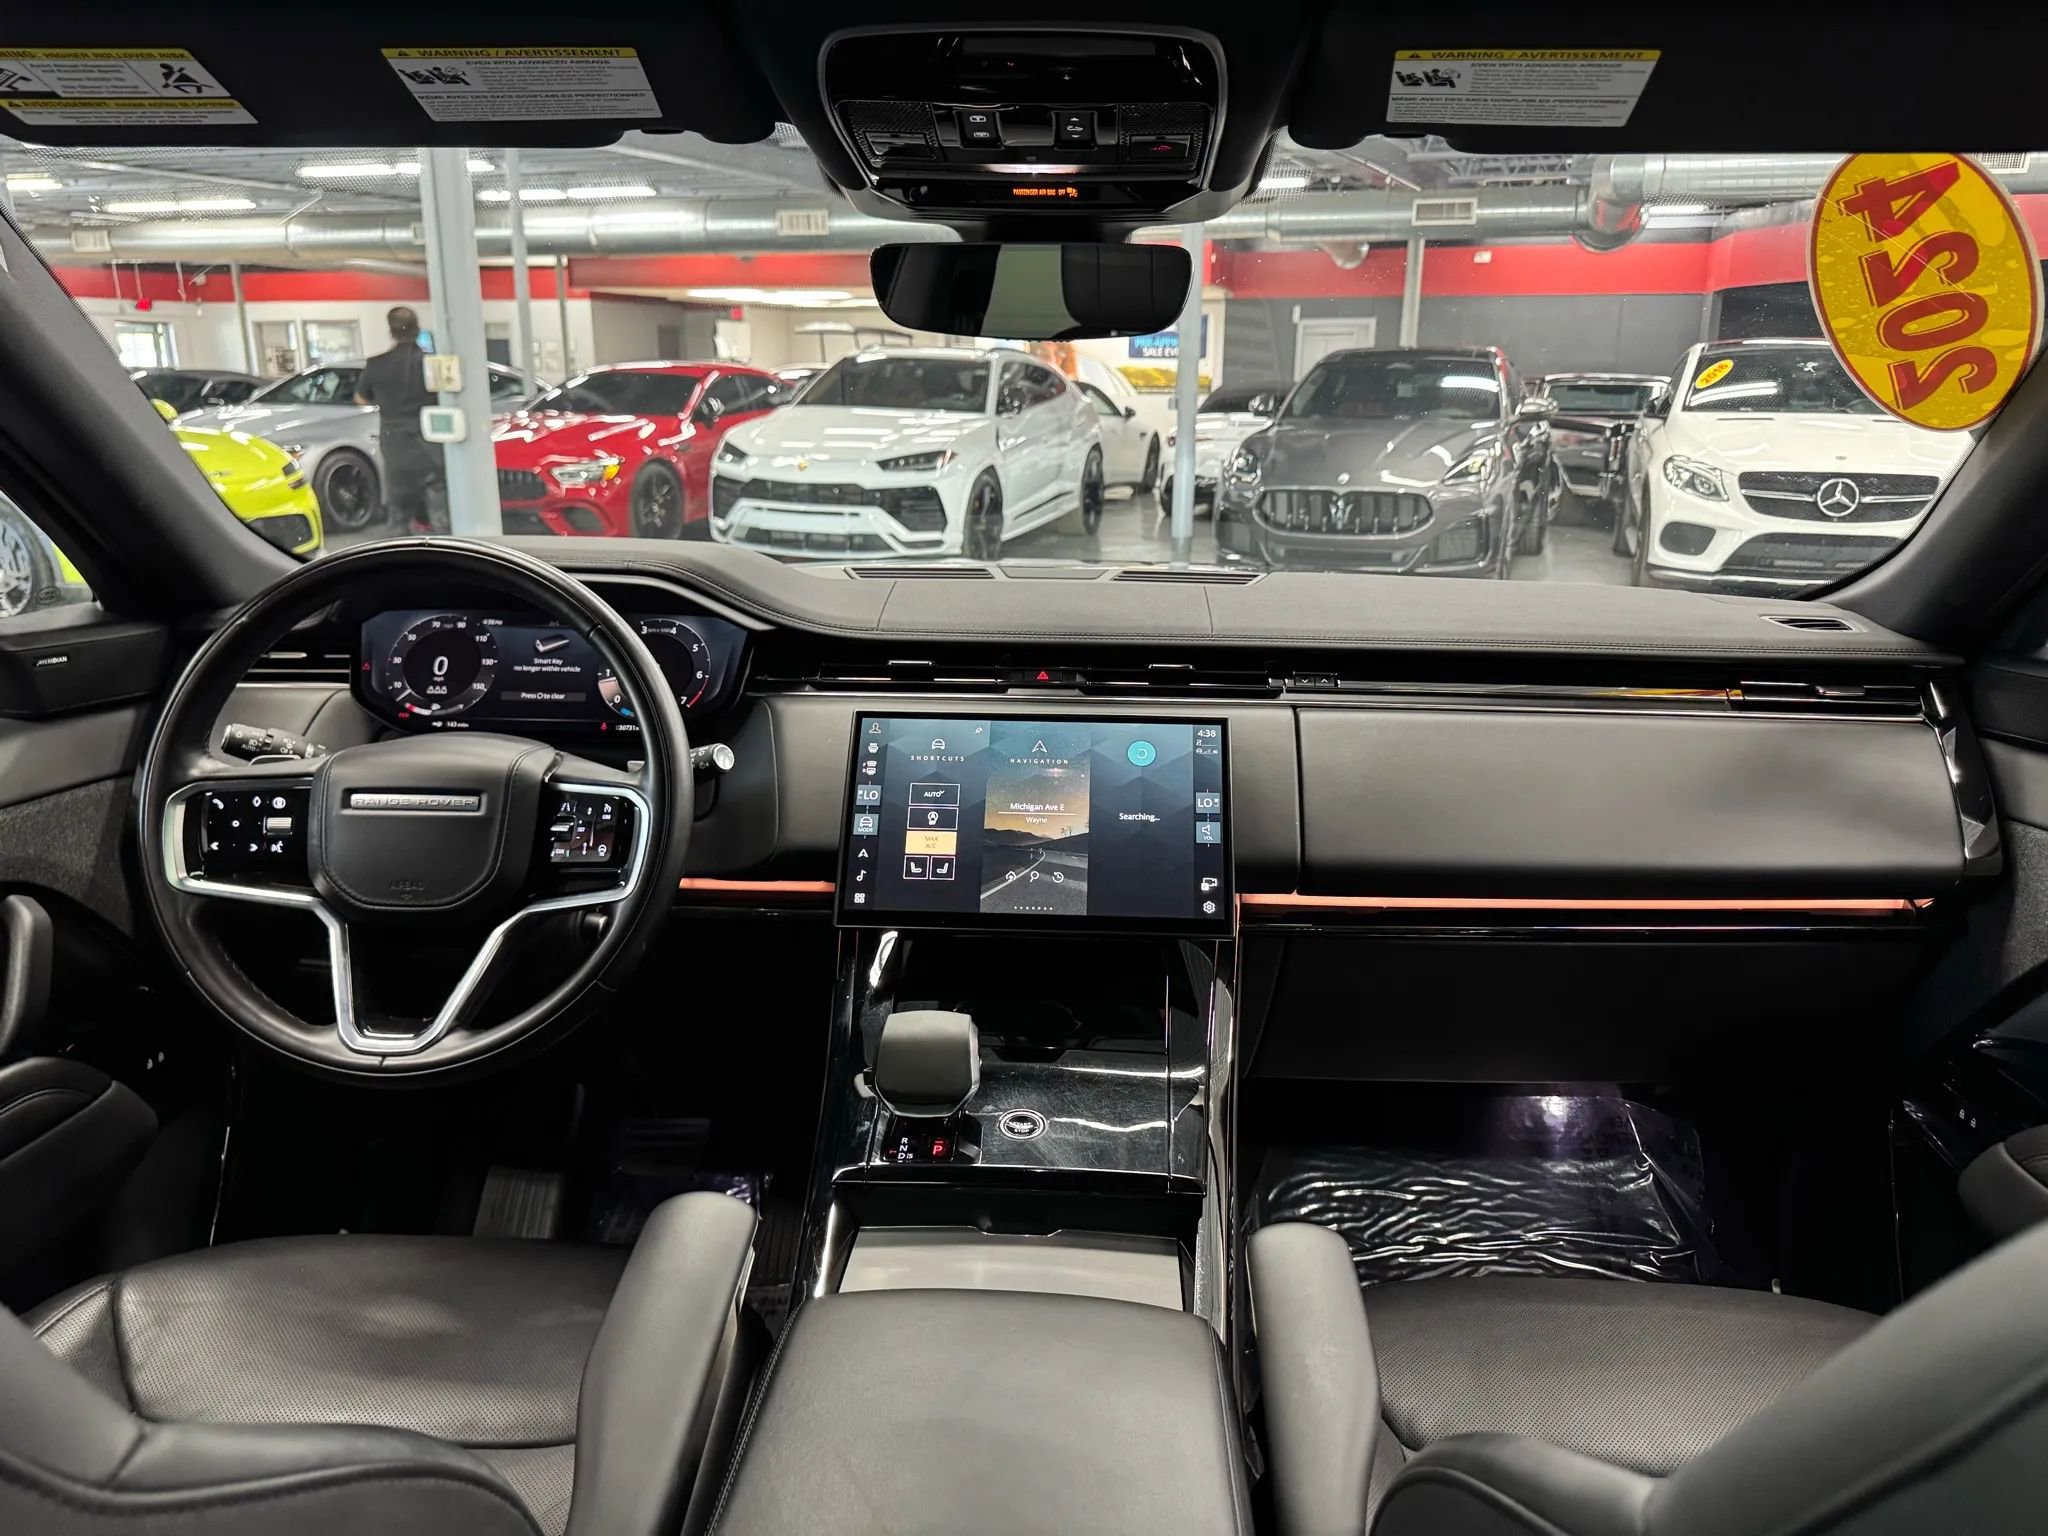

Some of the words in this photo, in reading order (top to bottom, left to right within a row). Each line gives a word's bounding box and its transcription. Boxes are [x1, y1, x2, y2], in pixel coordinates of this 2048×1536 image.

[1013, 188, 1038, 196] PASSENGER
[456, 621, 466, 629] 90
[641, 625, 648, 635] 3
[670, 626, 677, 635] 4
[692, 643, 699, 652] 5
[433, 656, 448, 676] 0
[482, 658, 494, 666] 130
[552, 658, 563, 666] Key
[523, 665, 541, 673] longer
[541, 665, 560, 673] within
[605, 668, 611, 676] 1
[696, 670, 703, 679] 6
[393, 681, 402, 689] 10
[614, 694, 621, 703] 0
[680, 696, 688, 705] 7
[1197, 729, 1216, 738] 4:38
[241, 743, 256, 752] AUTO
[863, 790, 879, 801] LO
[352, 798, 411, 807] RANGE
[416, 799, 474, 807] ROVER
[1197, 798, 1212, 808] LO
[1010, 803, 1043, 812] Michigan
[1026, 817, 1048, 825] Wayne
[933, 1145, 943, 1155] P
